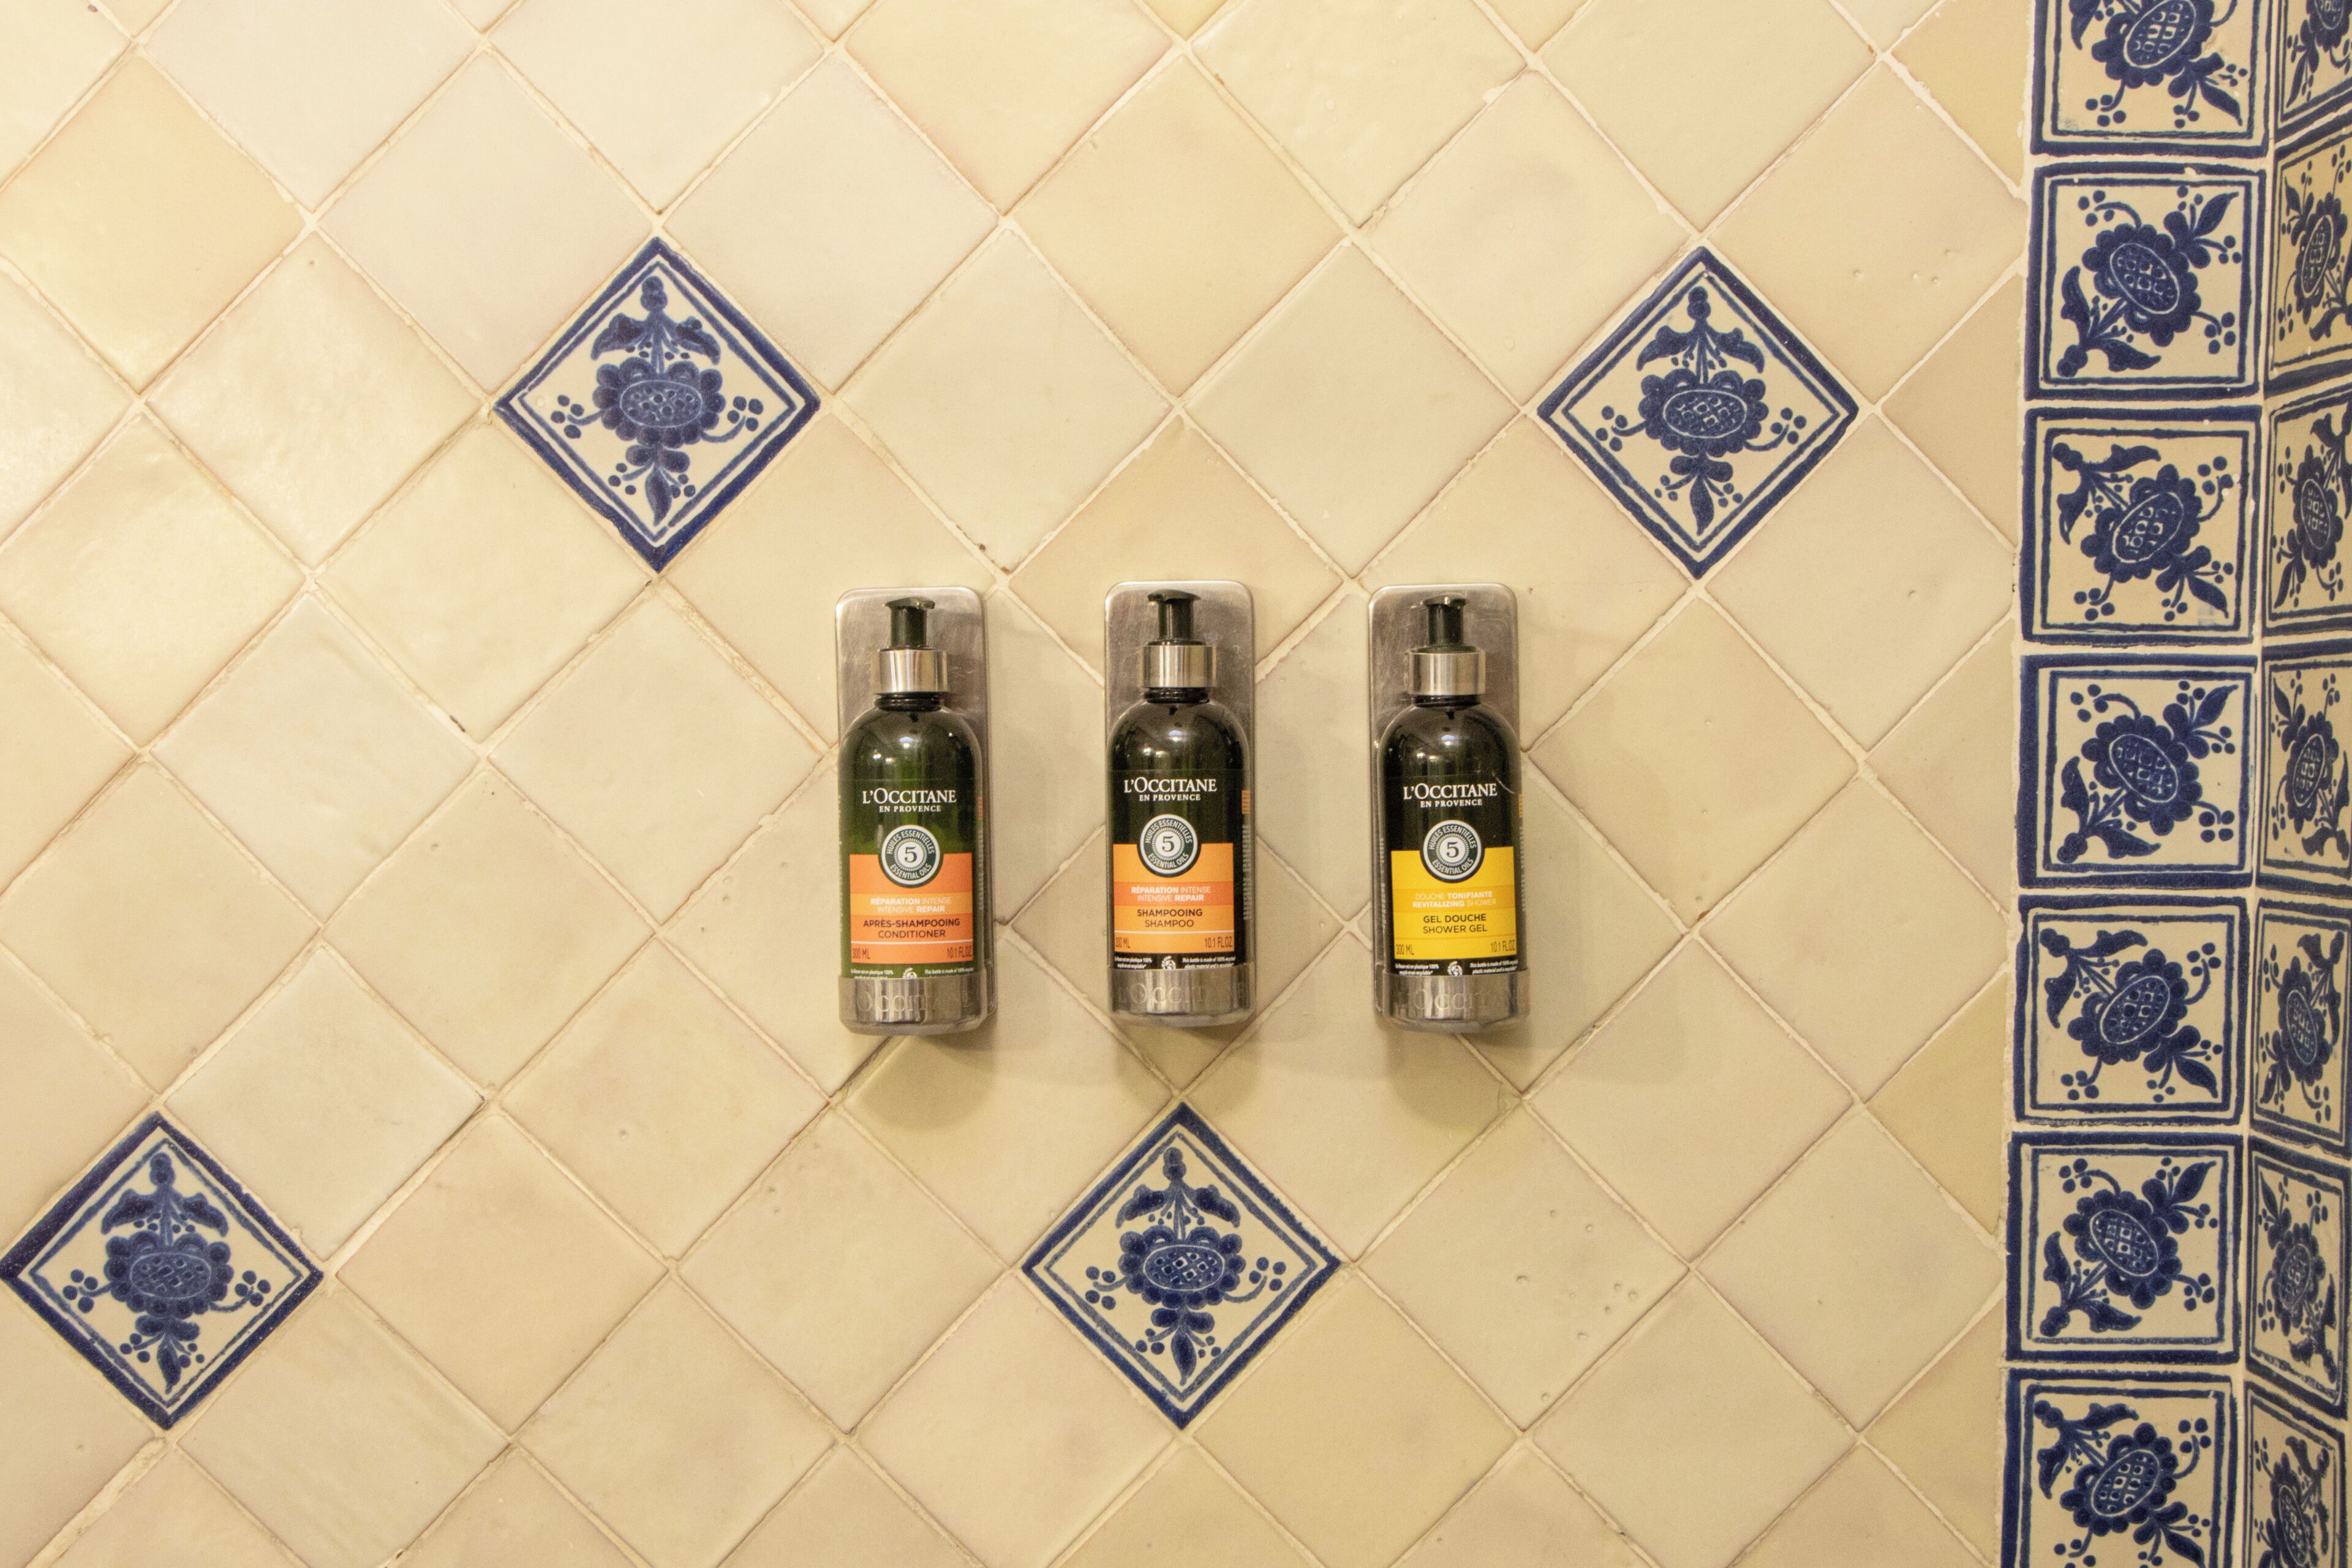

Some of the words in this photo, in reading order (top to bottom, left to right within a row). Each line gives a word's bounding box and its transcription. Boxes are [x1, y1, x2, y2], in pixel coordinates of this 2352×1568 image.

[1124, 777, 1217, 793] L'OCCITANE
[1403, 783, 1498, 800] L'OCCITANE
[862, 788, 957, 804] L'OCCITANE
[1435, 799, 1482, 807] PROVENCE
[1145, 823, 1159, 843] HUILES
[1158, 819, 1193, 843] ESSENTIELLES
[1428, 829, 1443, 850] HUILES
[1442, 824, 1477, 848] ESSENTIELLES
[886, 835, 902, 854] HUILES
[900, 830, 935, 854] ESSENTIELLES
[1162, 835, 1174, 852] 5
[1446, 842, 1459, 858] 5
[904, 846, 918, 863] 5
[1148, 853, 1177, 869] ESSENTIAL
[1177, 853, 1189, 867] OILS
[890, 863, 919, 880] ESSENTIAL
[919, 863, 932, 877] OILS
[1432, 859, 1463, 875] ESSENTIAL
[1461, 859, 1474, 872] OILS
[863, 918, 960, 927] APRÈS-SHAMPOOING
[1445, 913, 1486, 922] DOUCHE
[878, 930, 946, 938] CONDITIONER
[1423, 925, 1466, 933] SHOWER
[1469, 924, 1488, 932] GEL
[1123, 937, 1130, 948] ML
[1205, 937, 1216, 949] 10.1
[1396, 944, 1404, 955] 300
[1405, 944, 1414, 956] ML
[862, 948, 870, 959] ML
